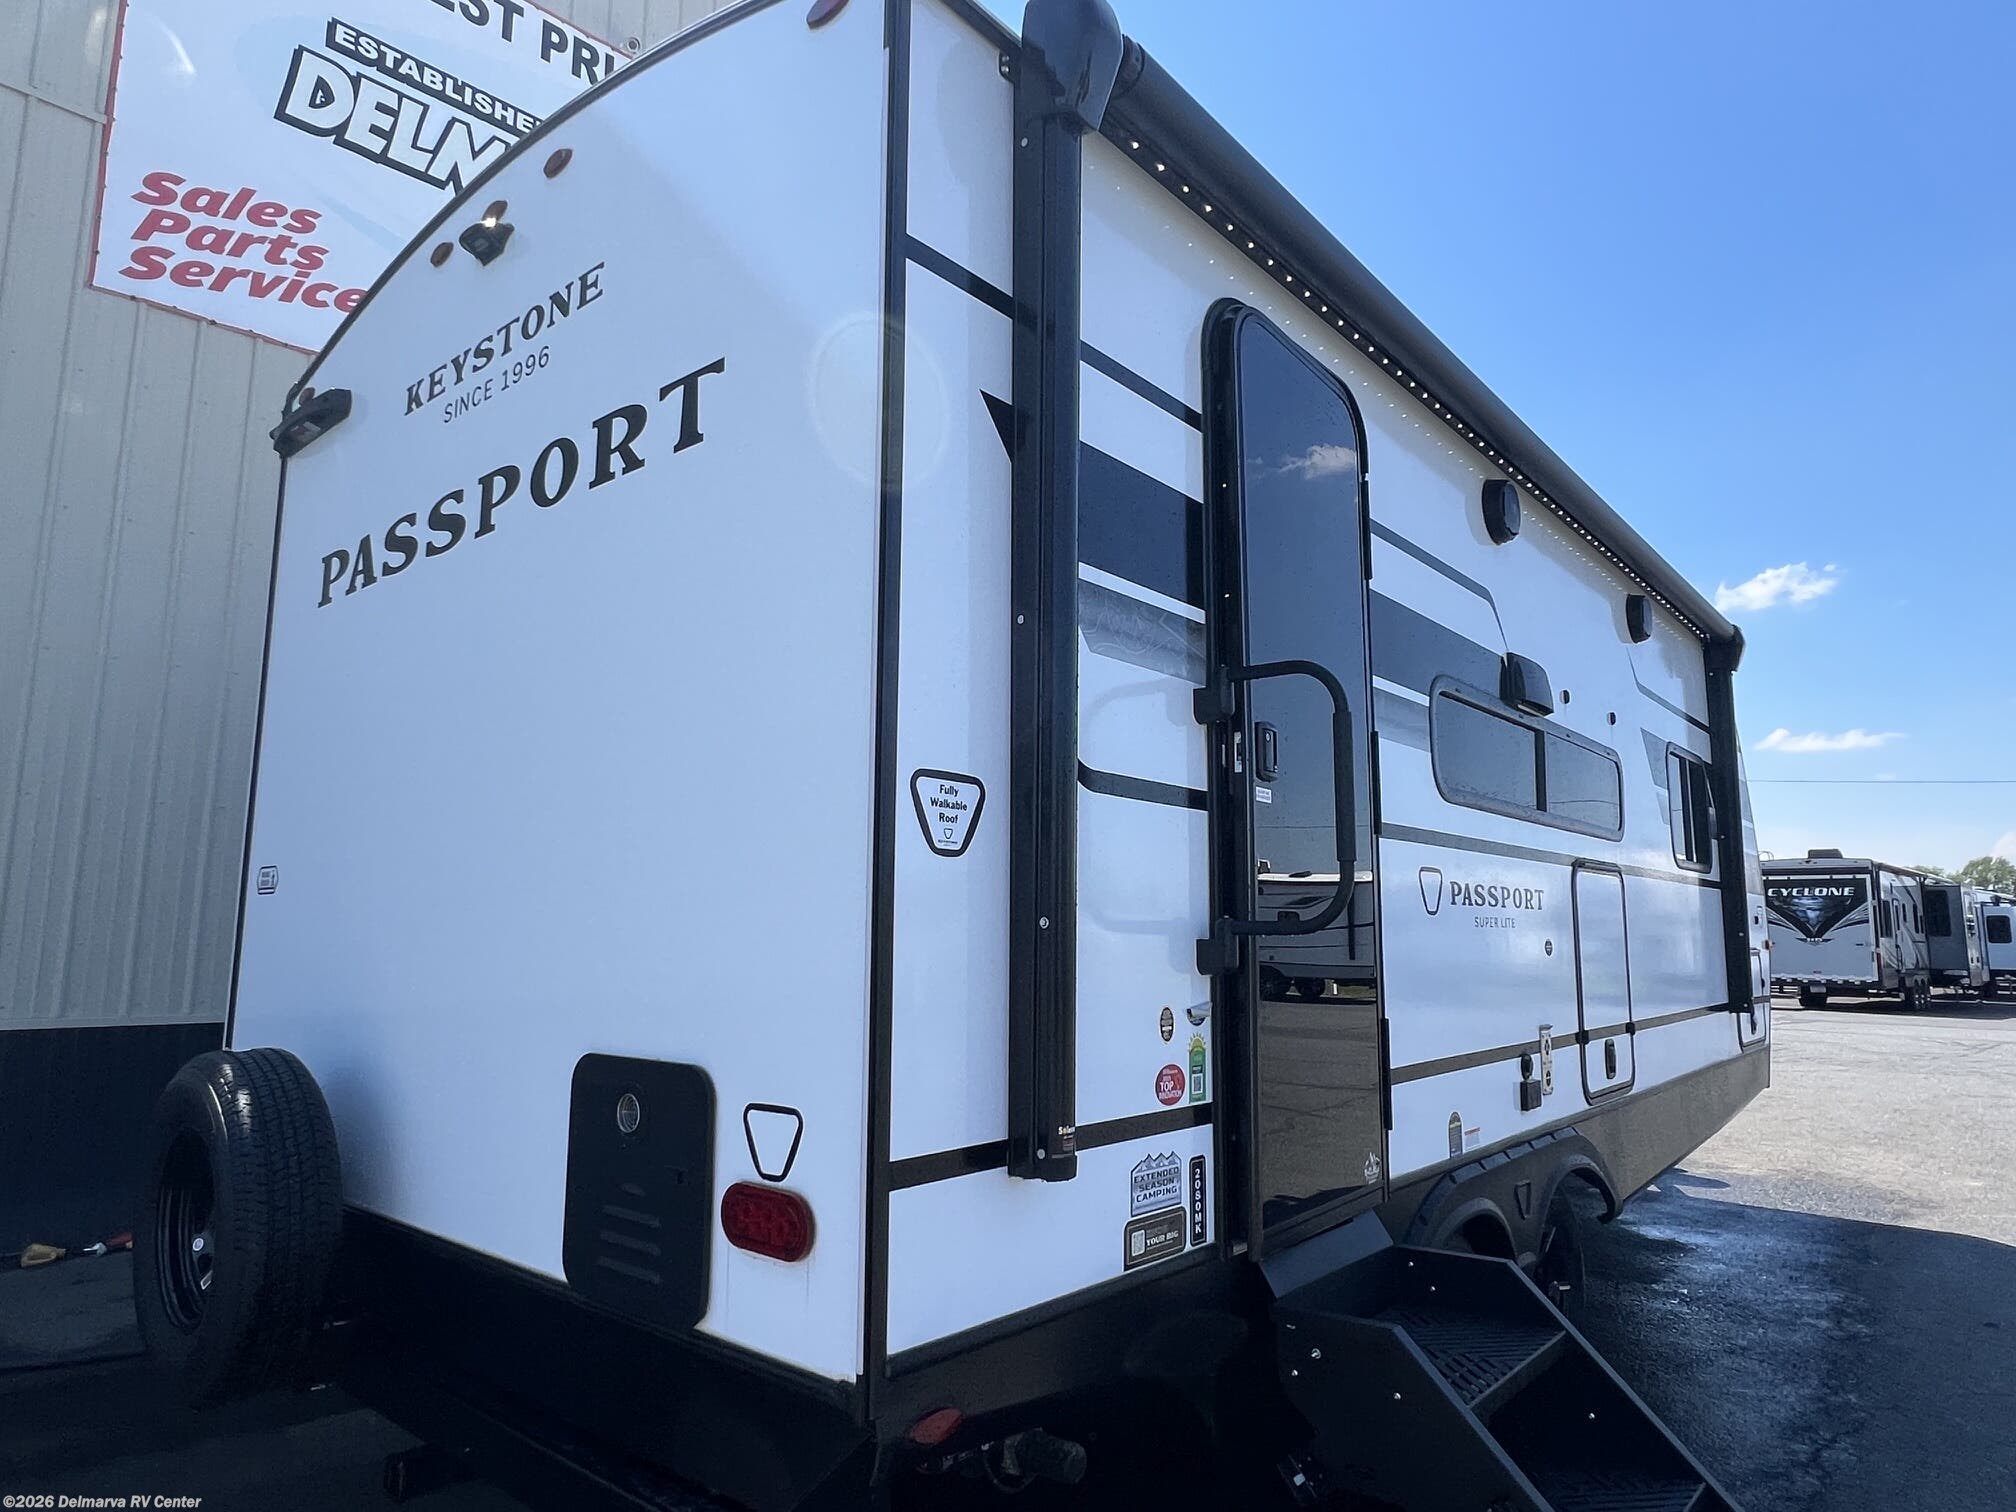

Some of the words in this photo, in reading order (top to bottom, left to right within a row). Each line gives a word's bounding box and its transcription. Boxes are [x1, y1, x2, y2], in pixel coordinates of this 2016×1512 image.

[333, 21, 544, 134] ESTABLISHE
[131, 172, 322, 234] Sales
[131, 208, 329, 270] Parts
[119, 246, 368, 313] Service
[404, 262, 605, 416] KEYSTONE
[444, 377, 493, 423] SINCE
[500, 345, 550, 391] 1996
[318, 356, 725, 608] PASSPORT
[939, 784, 959, 797] Fully
[930, 797, 968, 811] Walkable
[939, 812, 958, 823] Roof
[1450, 881, 1544, 910] PASSPORT
[1767, 886, 1855, 897] CYCLONE
[1474, 916, 1499, 928] SUPER
[1501, 917, 1516, 928] LITE
[1160, 1081, 1174, 1092] TOP
[1134, 1166, 1179, 1183] EXTENDED
[1136, 1185, 1177, 1203] CAMPING
[1138, 1177, 1175, 1193] SEASON
